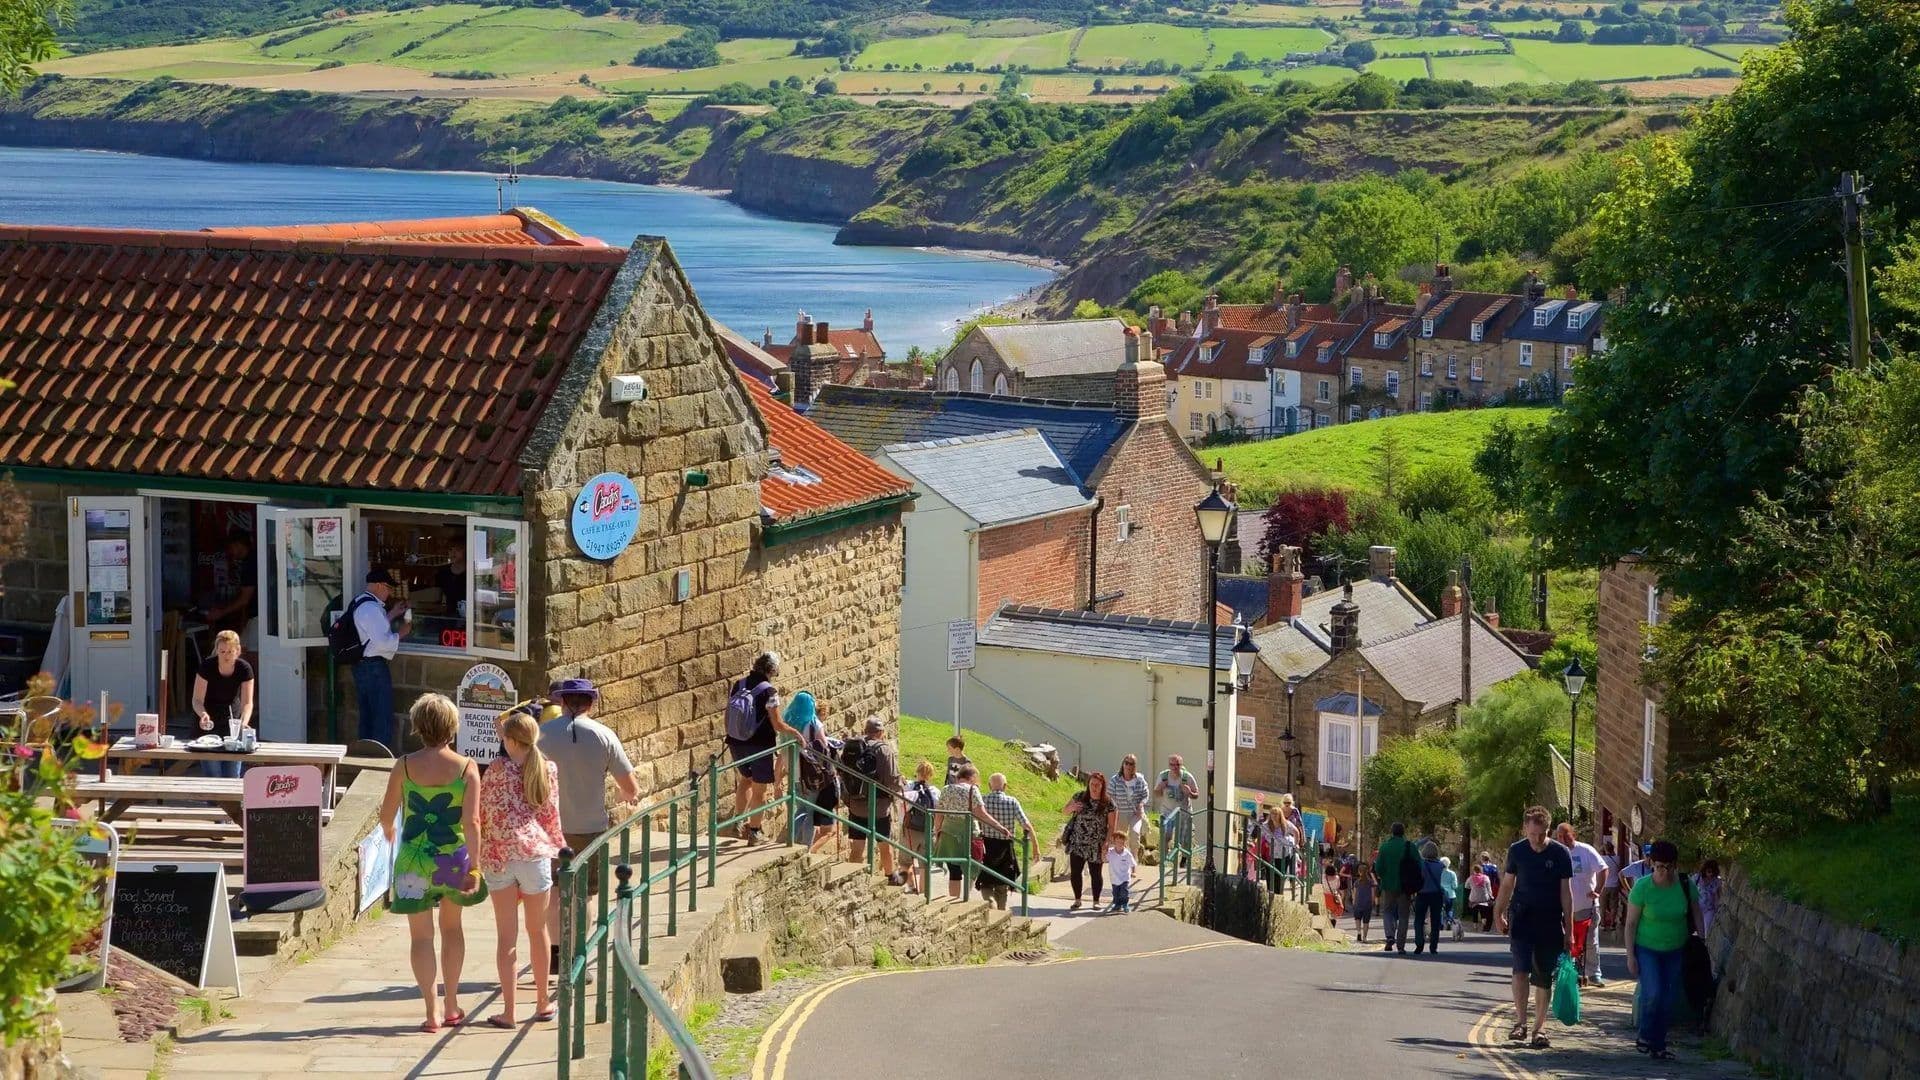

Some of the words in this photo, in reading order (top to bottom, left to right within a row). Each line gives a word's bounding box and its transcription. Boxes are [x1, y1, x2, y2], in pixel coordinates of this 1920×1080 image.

[442, 629, 467, 648] OPE
[466, 665, 491, 680] BEACON
[492, 666, 509, 683] FARM
[464, 713, 490, 722] BEACON
[466, 720, 497, 729] TRADITIO
[477, 728, 497, 737] DAIRY
[470, 735, 500, 744] ICE-CREA
[464, 747, 485, 759] sold
[488, 748, 500, 759] he
[118, 888, 138, 903] Food
[141, 888, 177, 903] Served
